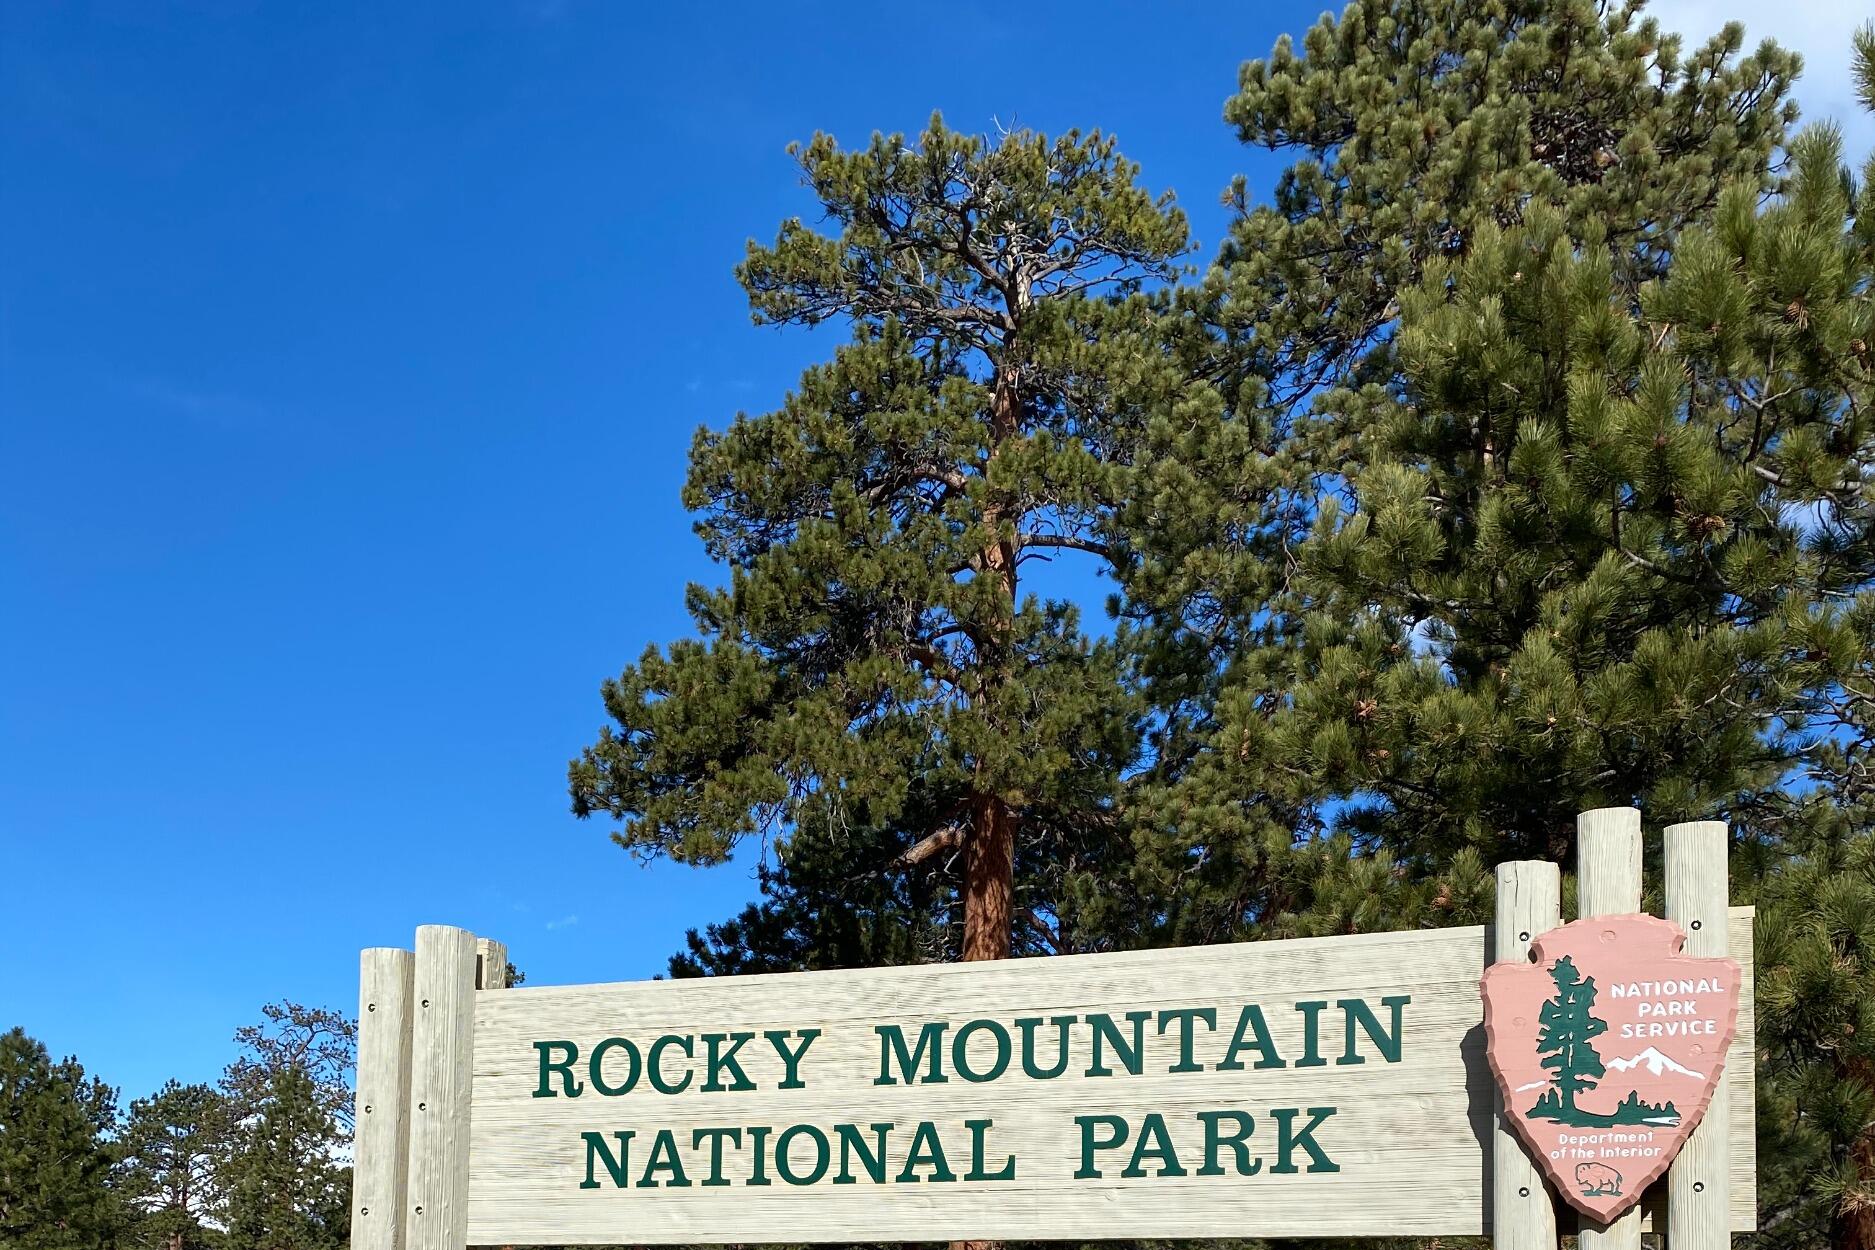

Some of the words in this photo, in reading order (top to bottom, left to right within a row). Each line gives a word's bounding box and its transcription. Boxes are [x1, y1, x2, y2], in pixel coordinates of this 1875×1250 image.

[1611, 977, 1724, 998] NATIONAL
[1638, 1000, 1697, 1017] PARK
[1620, 1020, 1718, 1038] SERVICE
[532, 1028, 821, 1098] ROCKY
[874, 995, 1411, 1086] MOUNTAIN
[579, 1119, 1016, 1189] NATIONAL
[1073, 1106, 1341, 1179] PARK
[1559, 1131, 1654, 1146] Department
[1551, 1147, 1567, 1159] of
[1571, 1147, 1595, 1159] the
[1600, 1145, 1661, 1158] Interior
